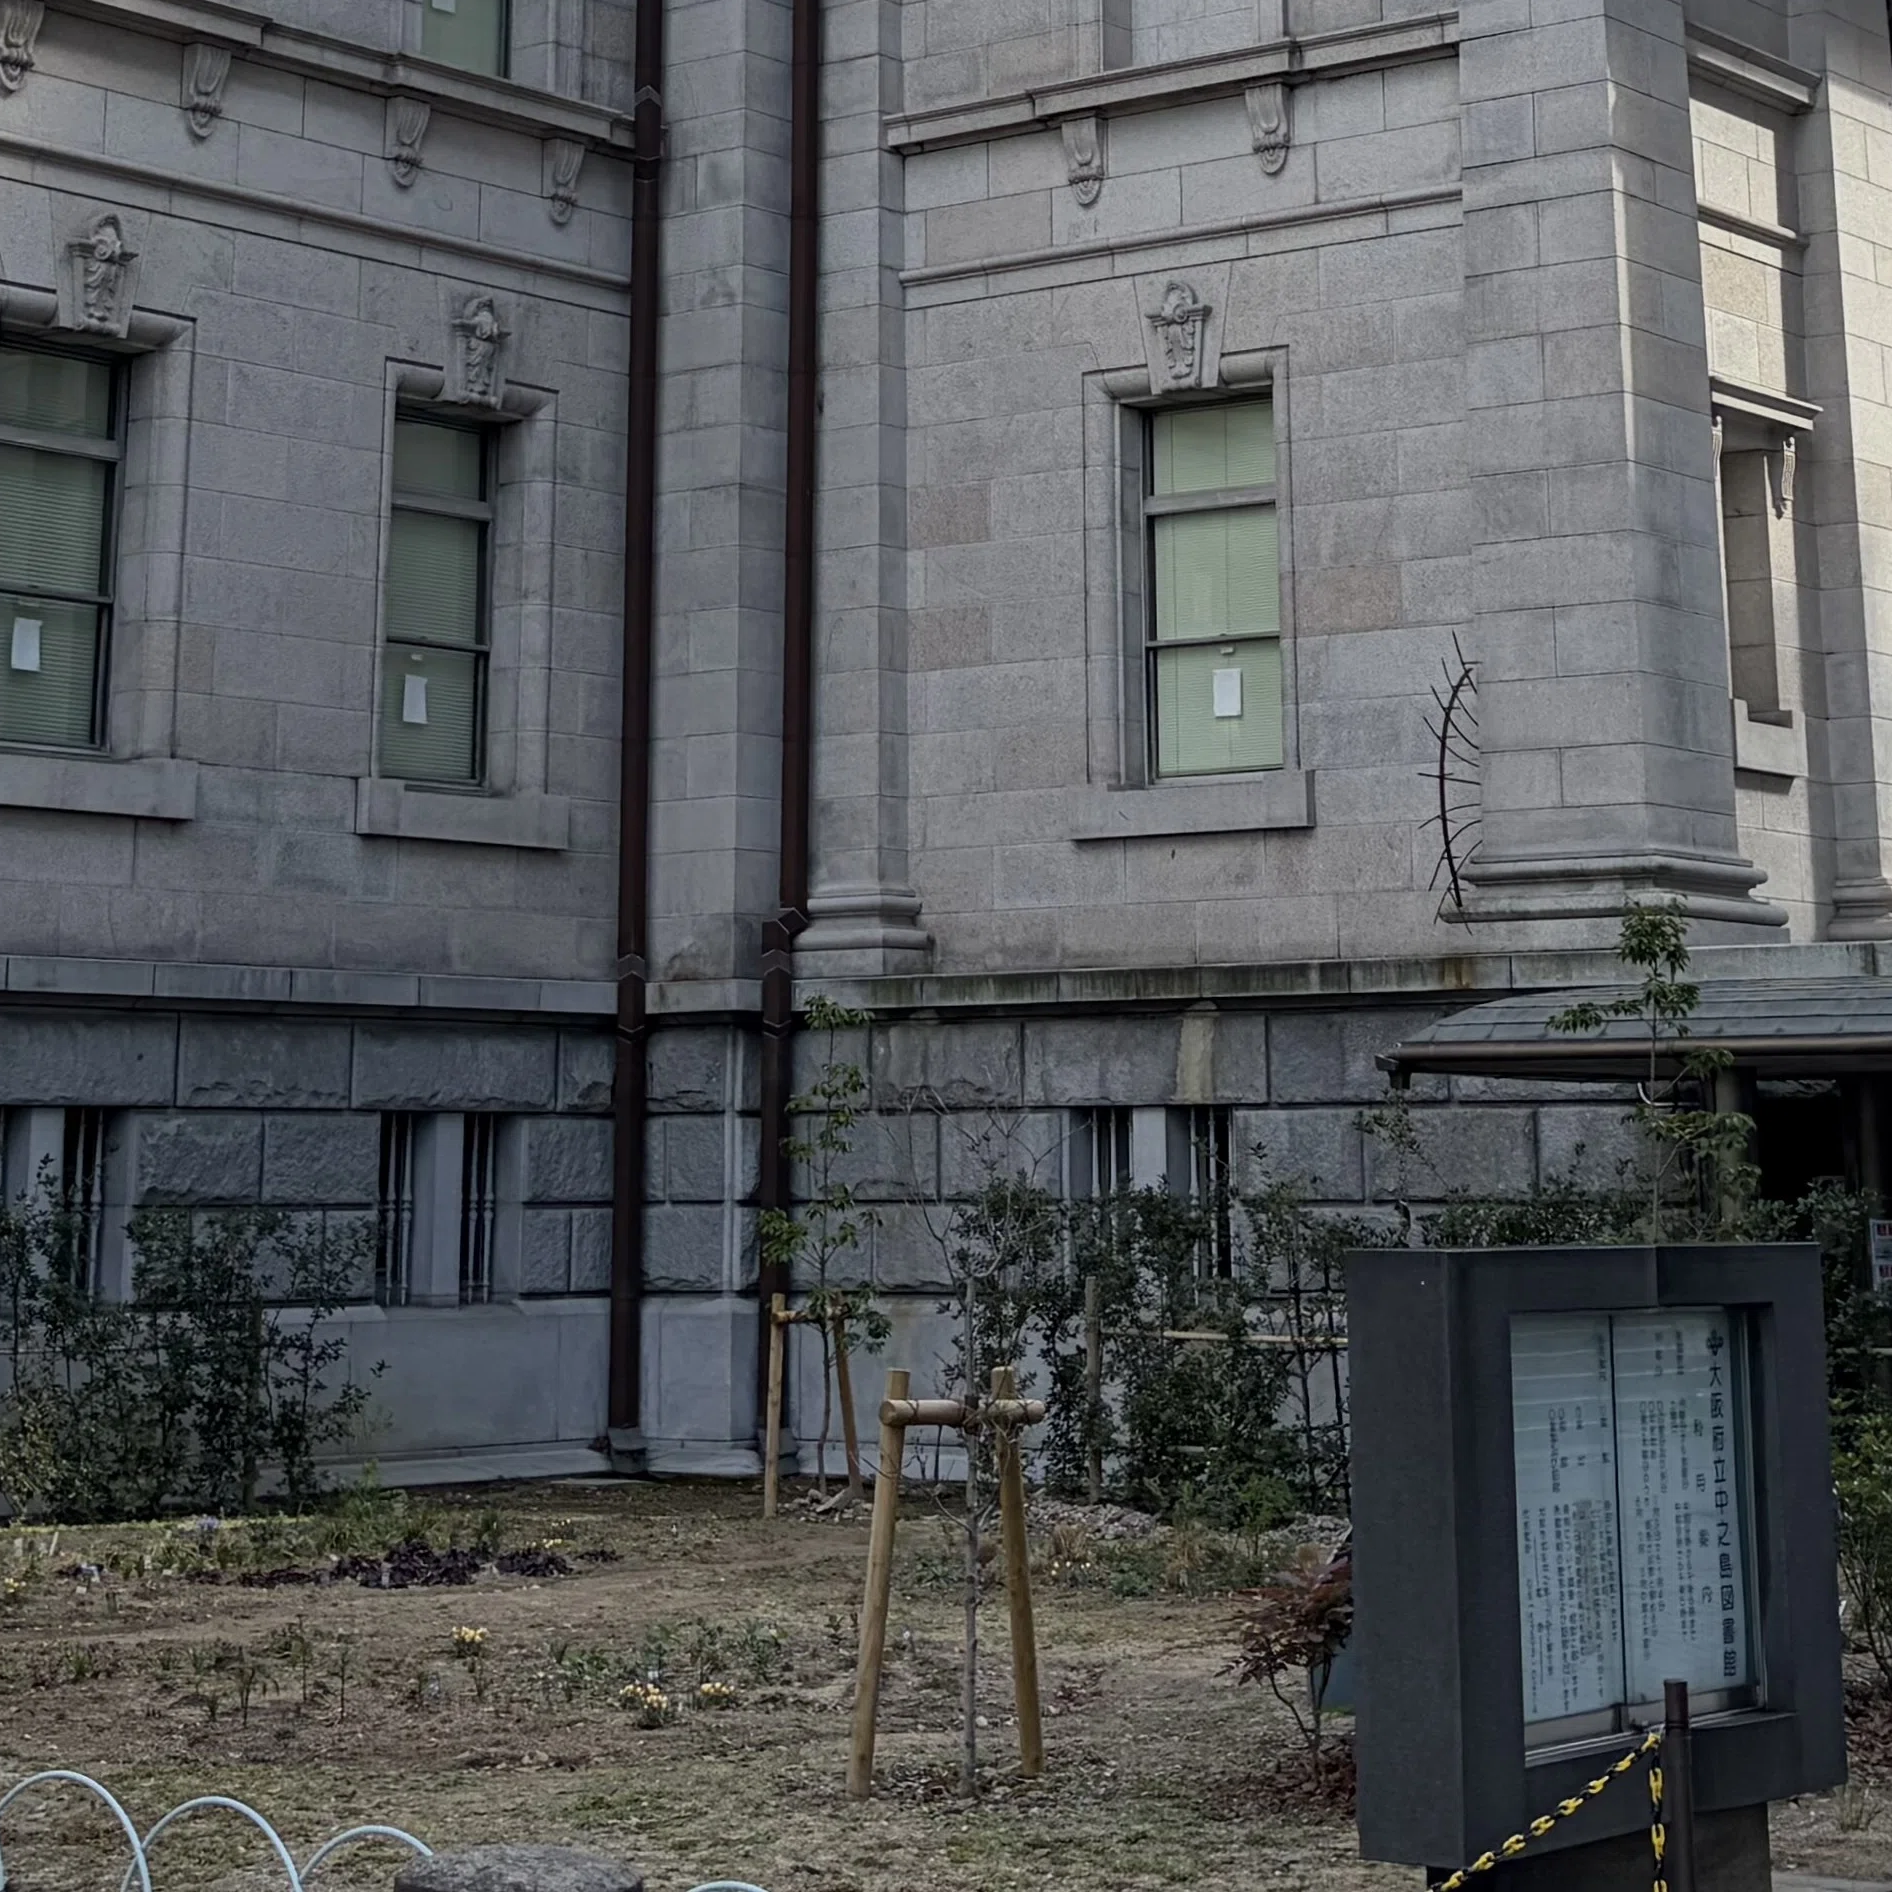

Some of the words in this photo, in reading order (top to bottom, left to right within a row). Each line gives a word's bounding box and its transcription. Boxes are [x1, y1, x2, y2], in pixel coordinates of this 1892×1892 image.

[1709, 1363, 1737, 1677] 大阪府立中之島図書館
